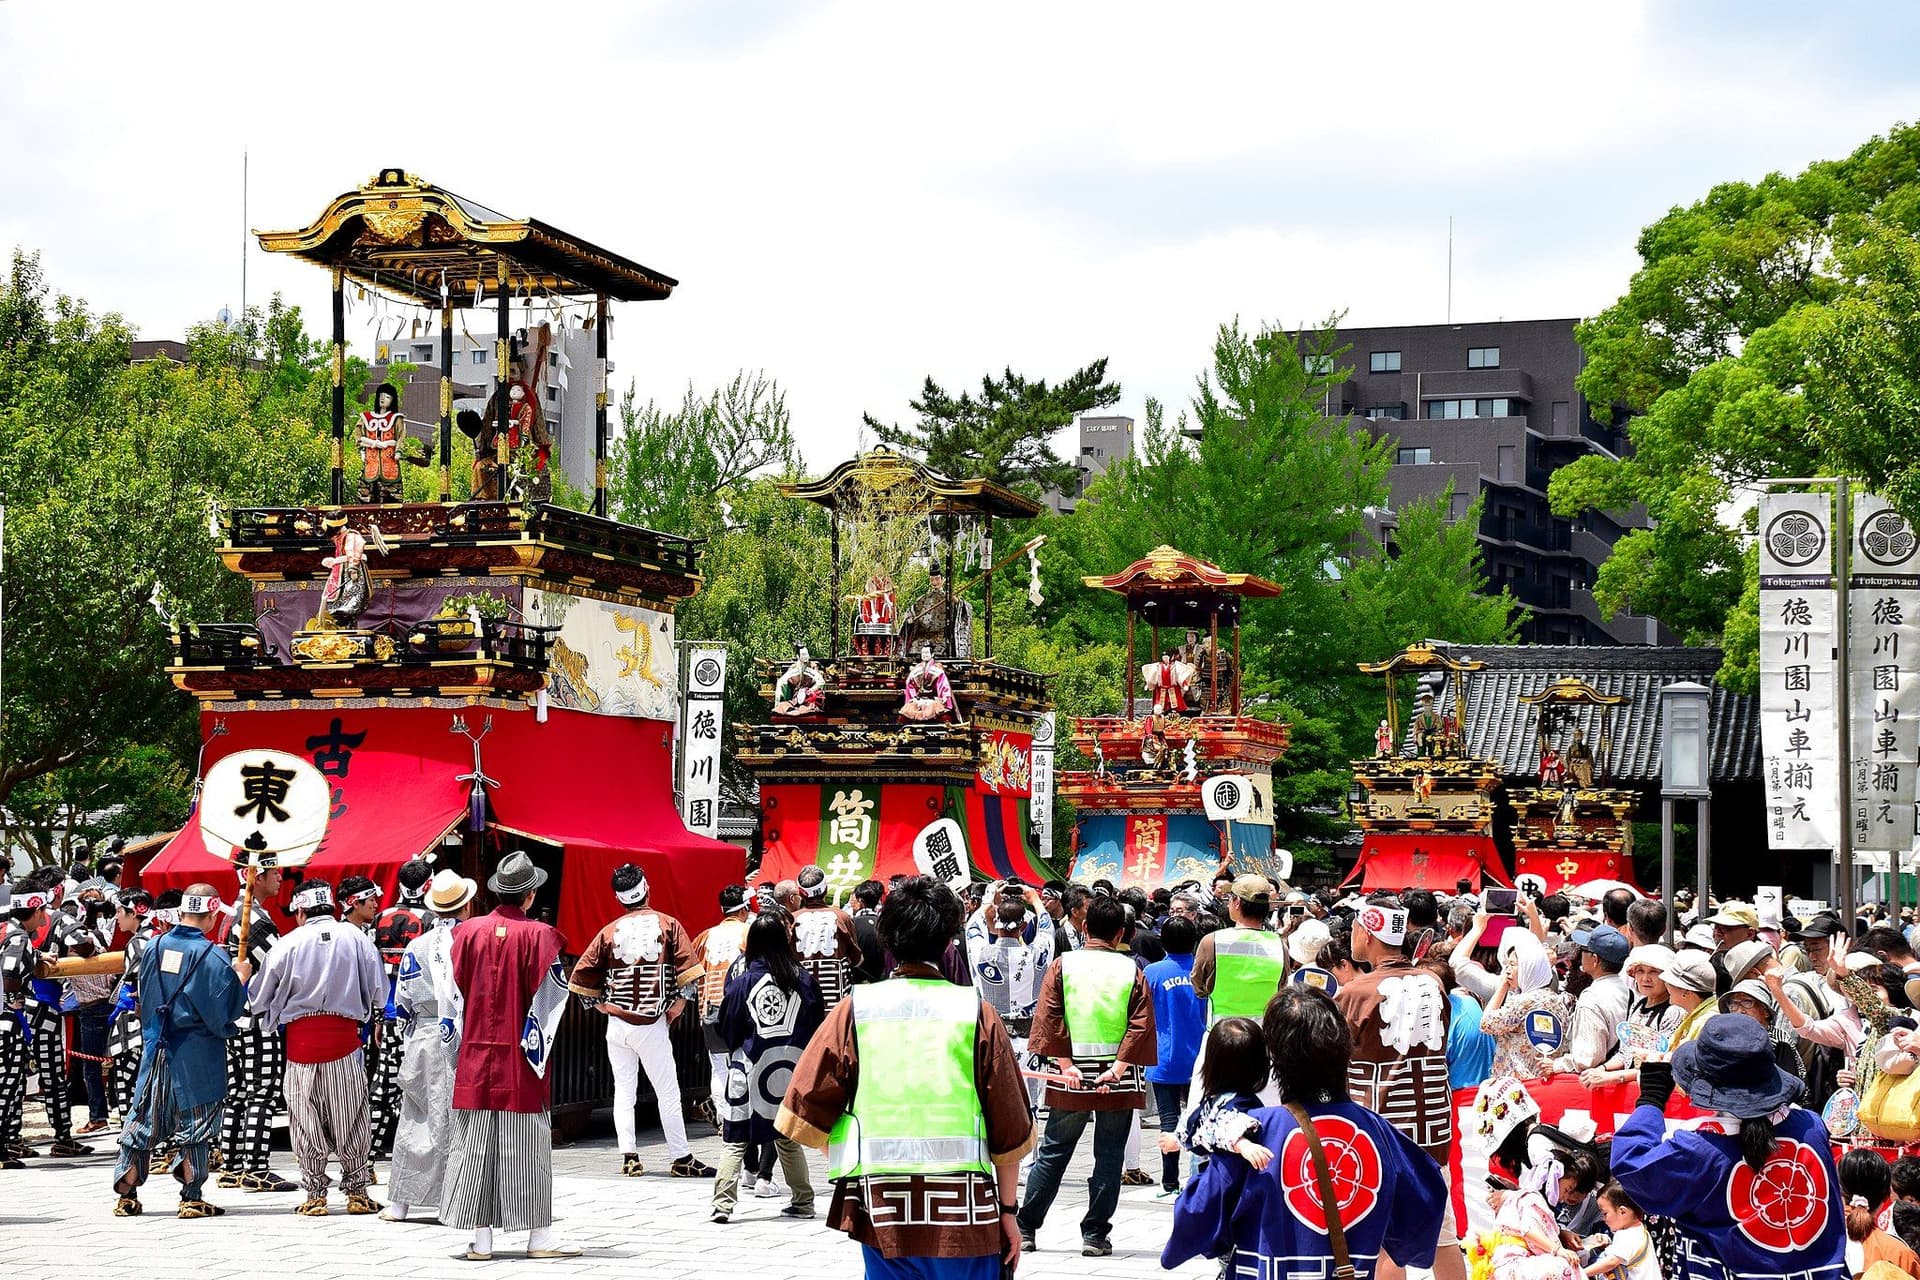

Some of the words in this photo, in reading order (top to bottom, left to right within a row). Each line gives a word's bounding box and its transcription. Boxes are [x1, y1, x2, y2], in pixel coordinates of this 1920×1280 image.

[1765, 577, 1826, 588] Tokugawaen
[1858, 576, 1919, 587] Tokugawaen
[1781, 597, 1814, 822] 徳川園山車揃え
[1871, 596, 1904, 824] 徳川園山車揃え
[690, 709, 718, 828] 徳川園
[1769, 756, 1786, 841] 六月第一日曜日
[1855, 756, 1869, 844] 六月第一日曜日
[1162, 976, 1193, 991] HIGA
